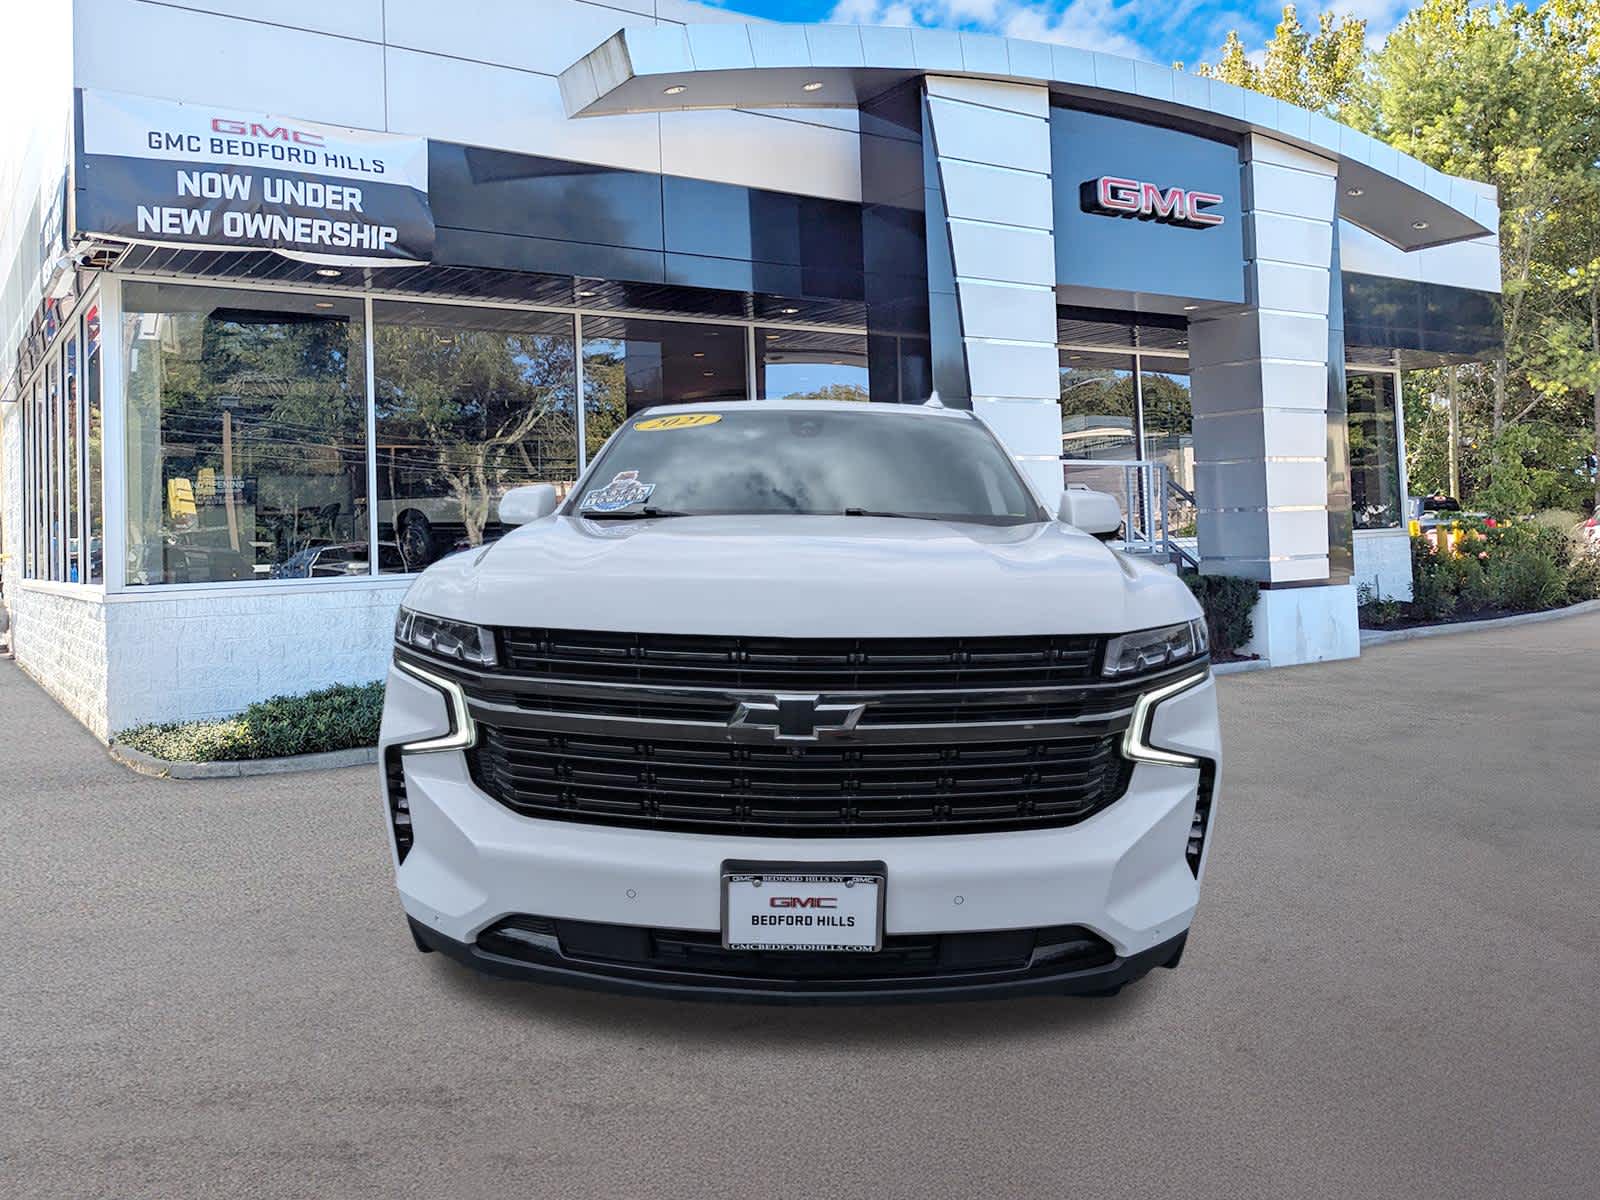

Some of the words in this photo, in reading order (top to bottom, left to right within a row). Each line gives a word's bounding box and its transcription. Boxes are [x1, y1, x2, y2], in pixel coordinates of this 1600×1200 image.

[148, 131, 201, 153] GMC
[210, 138, 317, 166] BEDFORD
[325, 154, 385, 174] HILLS
[211, 118, 326, 148] GMC
[177, 170, 252, 201] NOW
[263, 177, 364, 213] UNDER
[1097, 175, 1225, 225] GMC
[136, 205, 211, 236] NEW
[223, 211, 398, 250] OWNERSHIP
[751, 915, 813, 926] BEDFORD
[817, 916, 855, 927] HILLS
[769, 897, 838, 909] GMC
